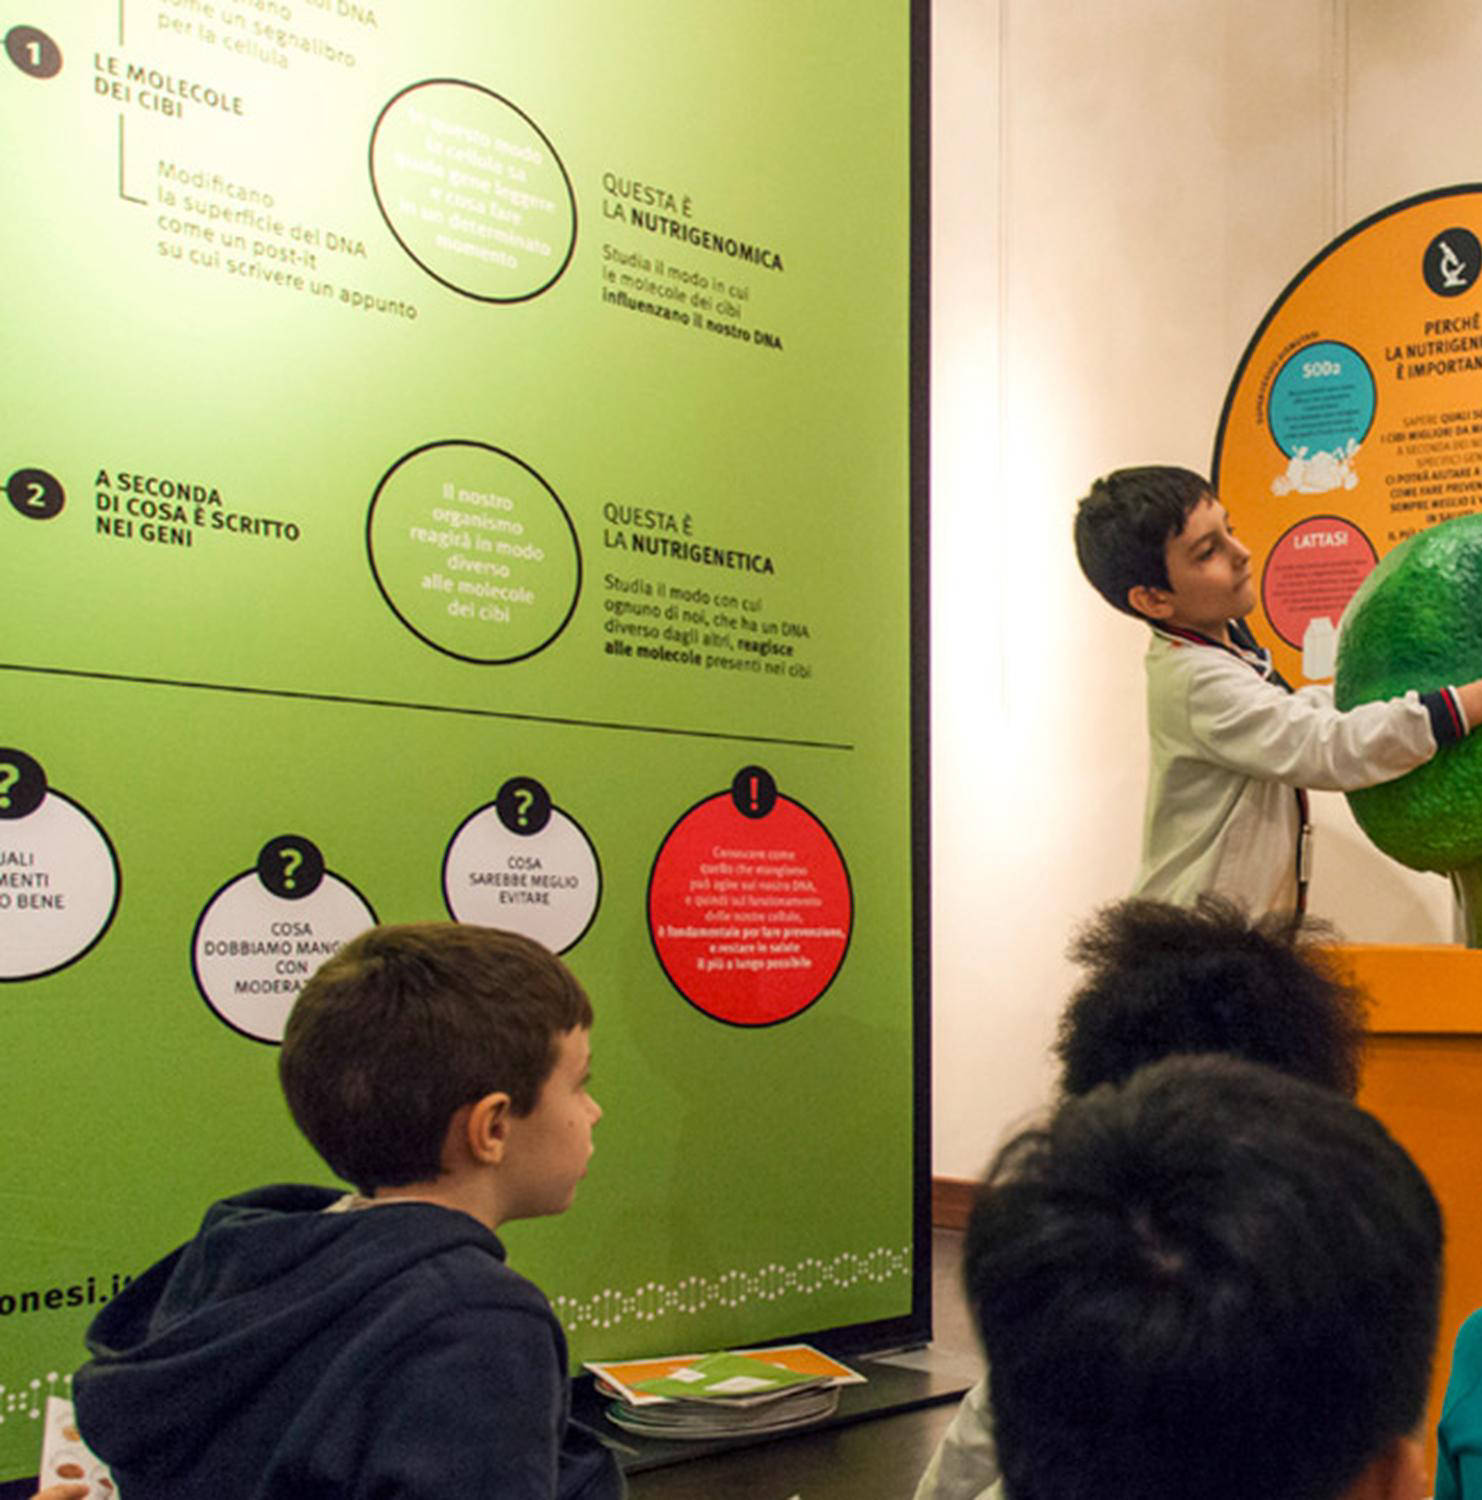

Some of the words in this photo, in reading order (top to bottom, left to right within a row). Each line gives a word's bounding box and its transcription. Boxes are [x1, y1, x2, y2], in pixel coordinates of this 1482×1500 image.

[25, 40, 40, 66] 1
[224, 36, 287, 68] cellula
[254, 20, 356, 68] segnalibro
[94, 52, 119, 76] LE
[127, 63, 244, 116] MOLECOLE
[94, 76, 131, 103] DEI
[139, 91, 183, 118] CIBI
[158, 160, 275, 208] Modificano
[603, 172, 678, 213] QUESTA
[158, 185, 176, 206] la
[183, 195, 284, 236] superficie
[291, 225, 319, 245] del
[326, 231, 368, 260] DNA
[603, 198, 626, 224] LA
[630, 207, 785, 272] NUTRIGENOMICA
[158, 214, 215, 242] come
[222, 232, 246, 250] un
[253, 239, 317, 271] post-it
[435, 233, 517, 269] momento
[158, 240, 183, 259] su
[190, 249, 220, 268] cui
[227, 258, 305, 291] scrivere
[311, 280, 334, 298] un
[340, 287, 418, 320] appunto
[603, 243, 651, 272] Studia
[668, 266, 709, 289] modo
[712, 276, 725, 294] in
[730, 285, 750, 303] cui
[603, 265, 616, 284] le
[621, 273, 686, 303] molecole
[691, 291, 713, 310] dei
[716, 299, 742, 320] cibi
[603, 286, 690, 326] influenzano
[693, 311, 704, 329] il
[707, 319, 751, 342] nostro
[754, 328, 784, 352] DNA
[1385, 345, 1403, 362] LA
[26, 482, 47, 507] 2
[95, 469, 111, 490] A
[117, 472, 223, 507] SECONDA
[459, 489, 514, 511] nostro
[96, 491, 120, 512] DI
[126, 496, 188, 525] COSA
[194, 505, 206, 527] È
[212, 510, 301, 542] SCRITTO
[96, 516, 133, 539] NEI
[140, 521, 193, 548] GENI
[433, 507, 524, 536] organismo
[603, 502, 679, 532] QUESTA
[410, 527, 470, 549] reagirà
[476, 534, 492, 552] in
[496, 541, 545, 562] modo
[603, 528, 627, 551] LA
[631, 532, 775, 576] NUTRIGENETICA
[1294, 532, 1349, 550] LATTASI
[448, 553, 510, 578] diverso
[422, 573, 454, 593] alle
[458, 582, 535, 605] molecole
[604, 573, 653, 597] Studia
[657, 581, 666, 598] il
[670, 586, 710, 605] modo
[714, 593, 738, 609] con
[742, 596, 762, 613] cui
[448, 598, 474, 618] dei
[479, 603, 510, 623] cibi
[604, 598, 660, 617] ognuno
[665, 604, 678, 620] di
[713, 613, 737, 630] che
[741, 616, 757, 632] ha
[762, 621, 778, 635] un
[781, 620, 812, 639] DNA
[604, 618, 659, 639] diverso
[663, 625, 698, 647] dagli
[737, 637, 794, 657] reagisce
[604, 639, 632, 657] alle
[636, 644, 702, 667] molecole
[705, 653, 761, 675] presenti
[765, 661, 785, 676] nei
[789, 663, 813, 680] cibi
[513, 790, 533, 826] ?
[278, 848, 304, 890] ?
[469, 872, 527, 887] SAREBBE
[531, 874, 579, 889] MEGLIO
[506, 856, 543, 870] COSA
[17, 893, 65, 910] BENE
[498, 891, 551, 905] EVITARE
[270, 921, 313, 936] COSA
[204, 940, 293, 957] DOBBIAMO
[275, 959, 309, 975] CON
